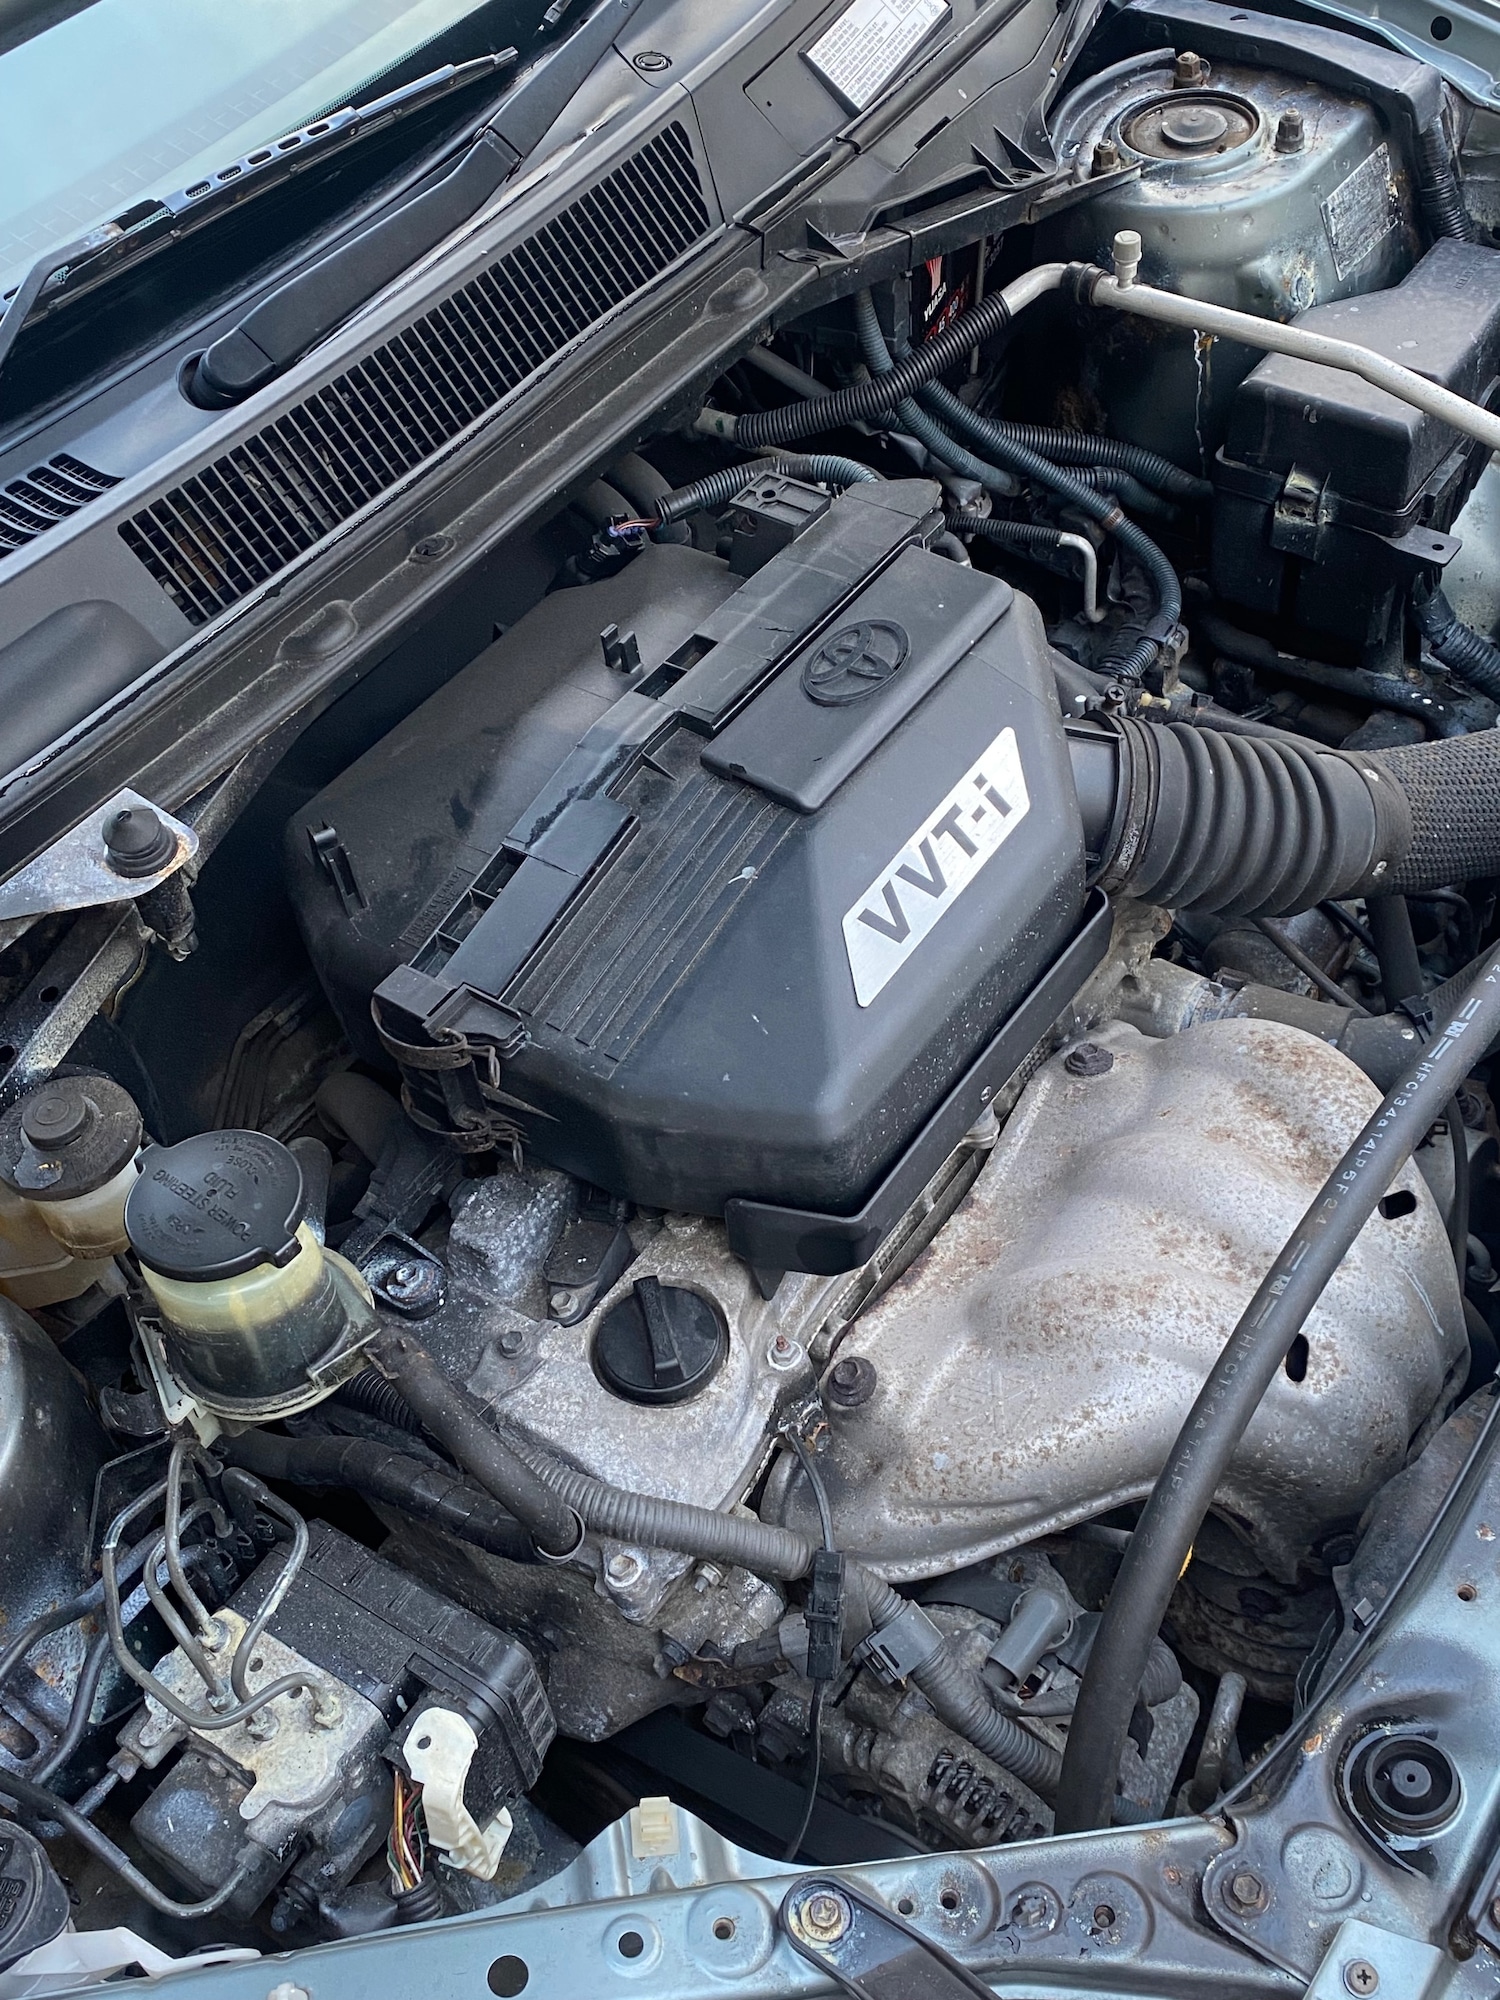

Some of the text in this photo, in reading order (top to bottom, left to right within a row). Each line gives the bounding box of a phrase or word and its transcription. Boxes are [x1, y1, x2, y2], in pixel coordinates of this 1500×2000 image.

[923, 281, 946, 321] YUASA
[857, 773, 1012, 944] VVT-i
[1376, 1061, 1434, 1127] HFC134a
[226, 1154, 257, 1176] CLOSE
[152, 1168, 211, 1210] STEERING
[203, 1171, 239, 1200] FLUID
[207, 1205, 252, 1242] POWER
